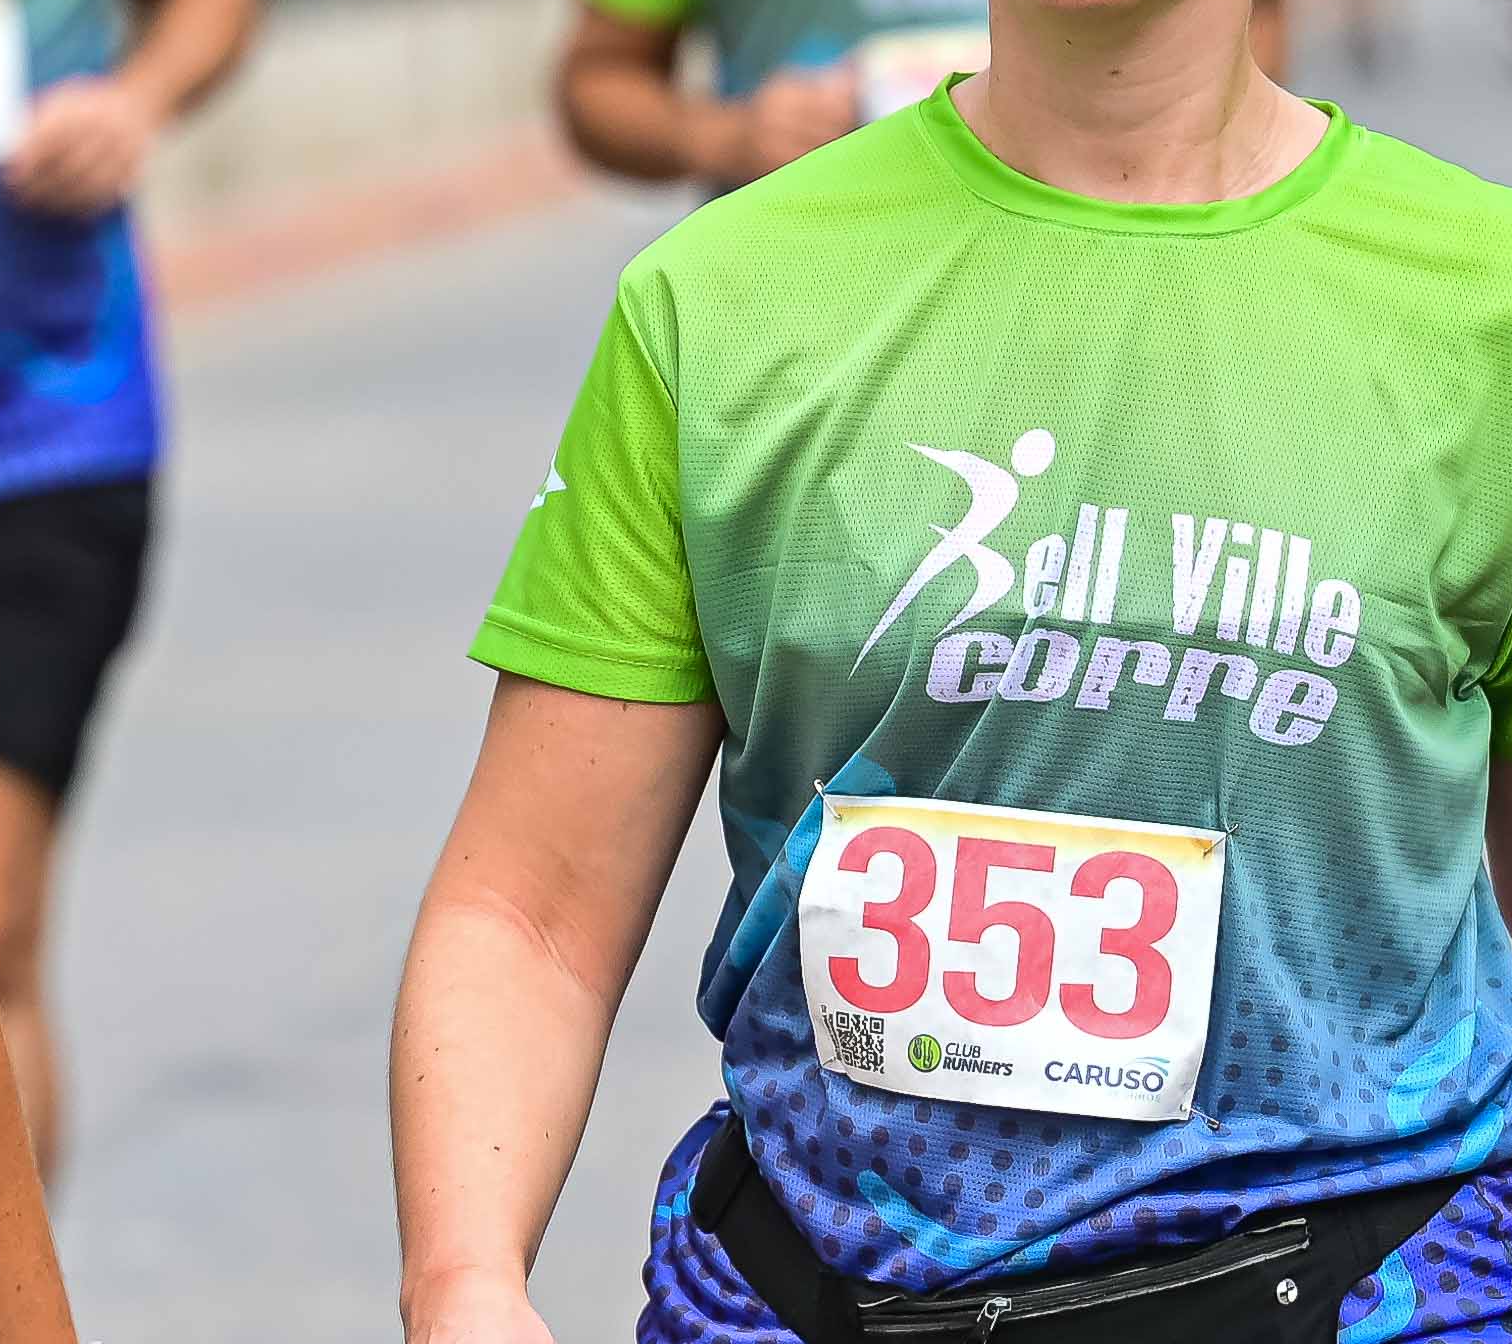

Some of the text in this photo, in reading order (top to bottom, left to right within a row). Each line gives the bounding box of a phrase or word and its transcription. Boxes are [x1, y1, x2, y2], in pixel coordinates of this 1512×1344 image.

[1170, 512, 1361, 668] Ville
[925, 628, 1338, 746] corre
[829, 826, 1178, 1040] 353
[945, 1043, 981, 1058] CLUB
[1044, 1060, 1164, 1092] CARUSO
